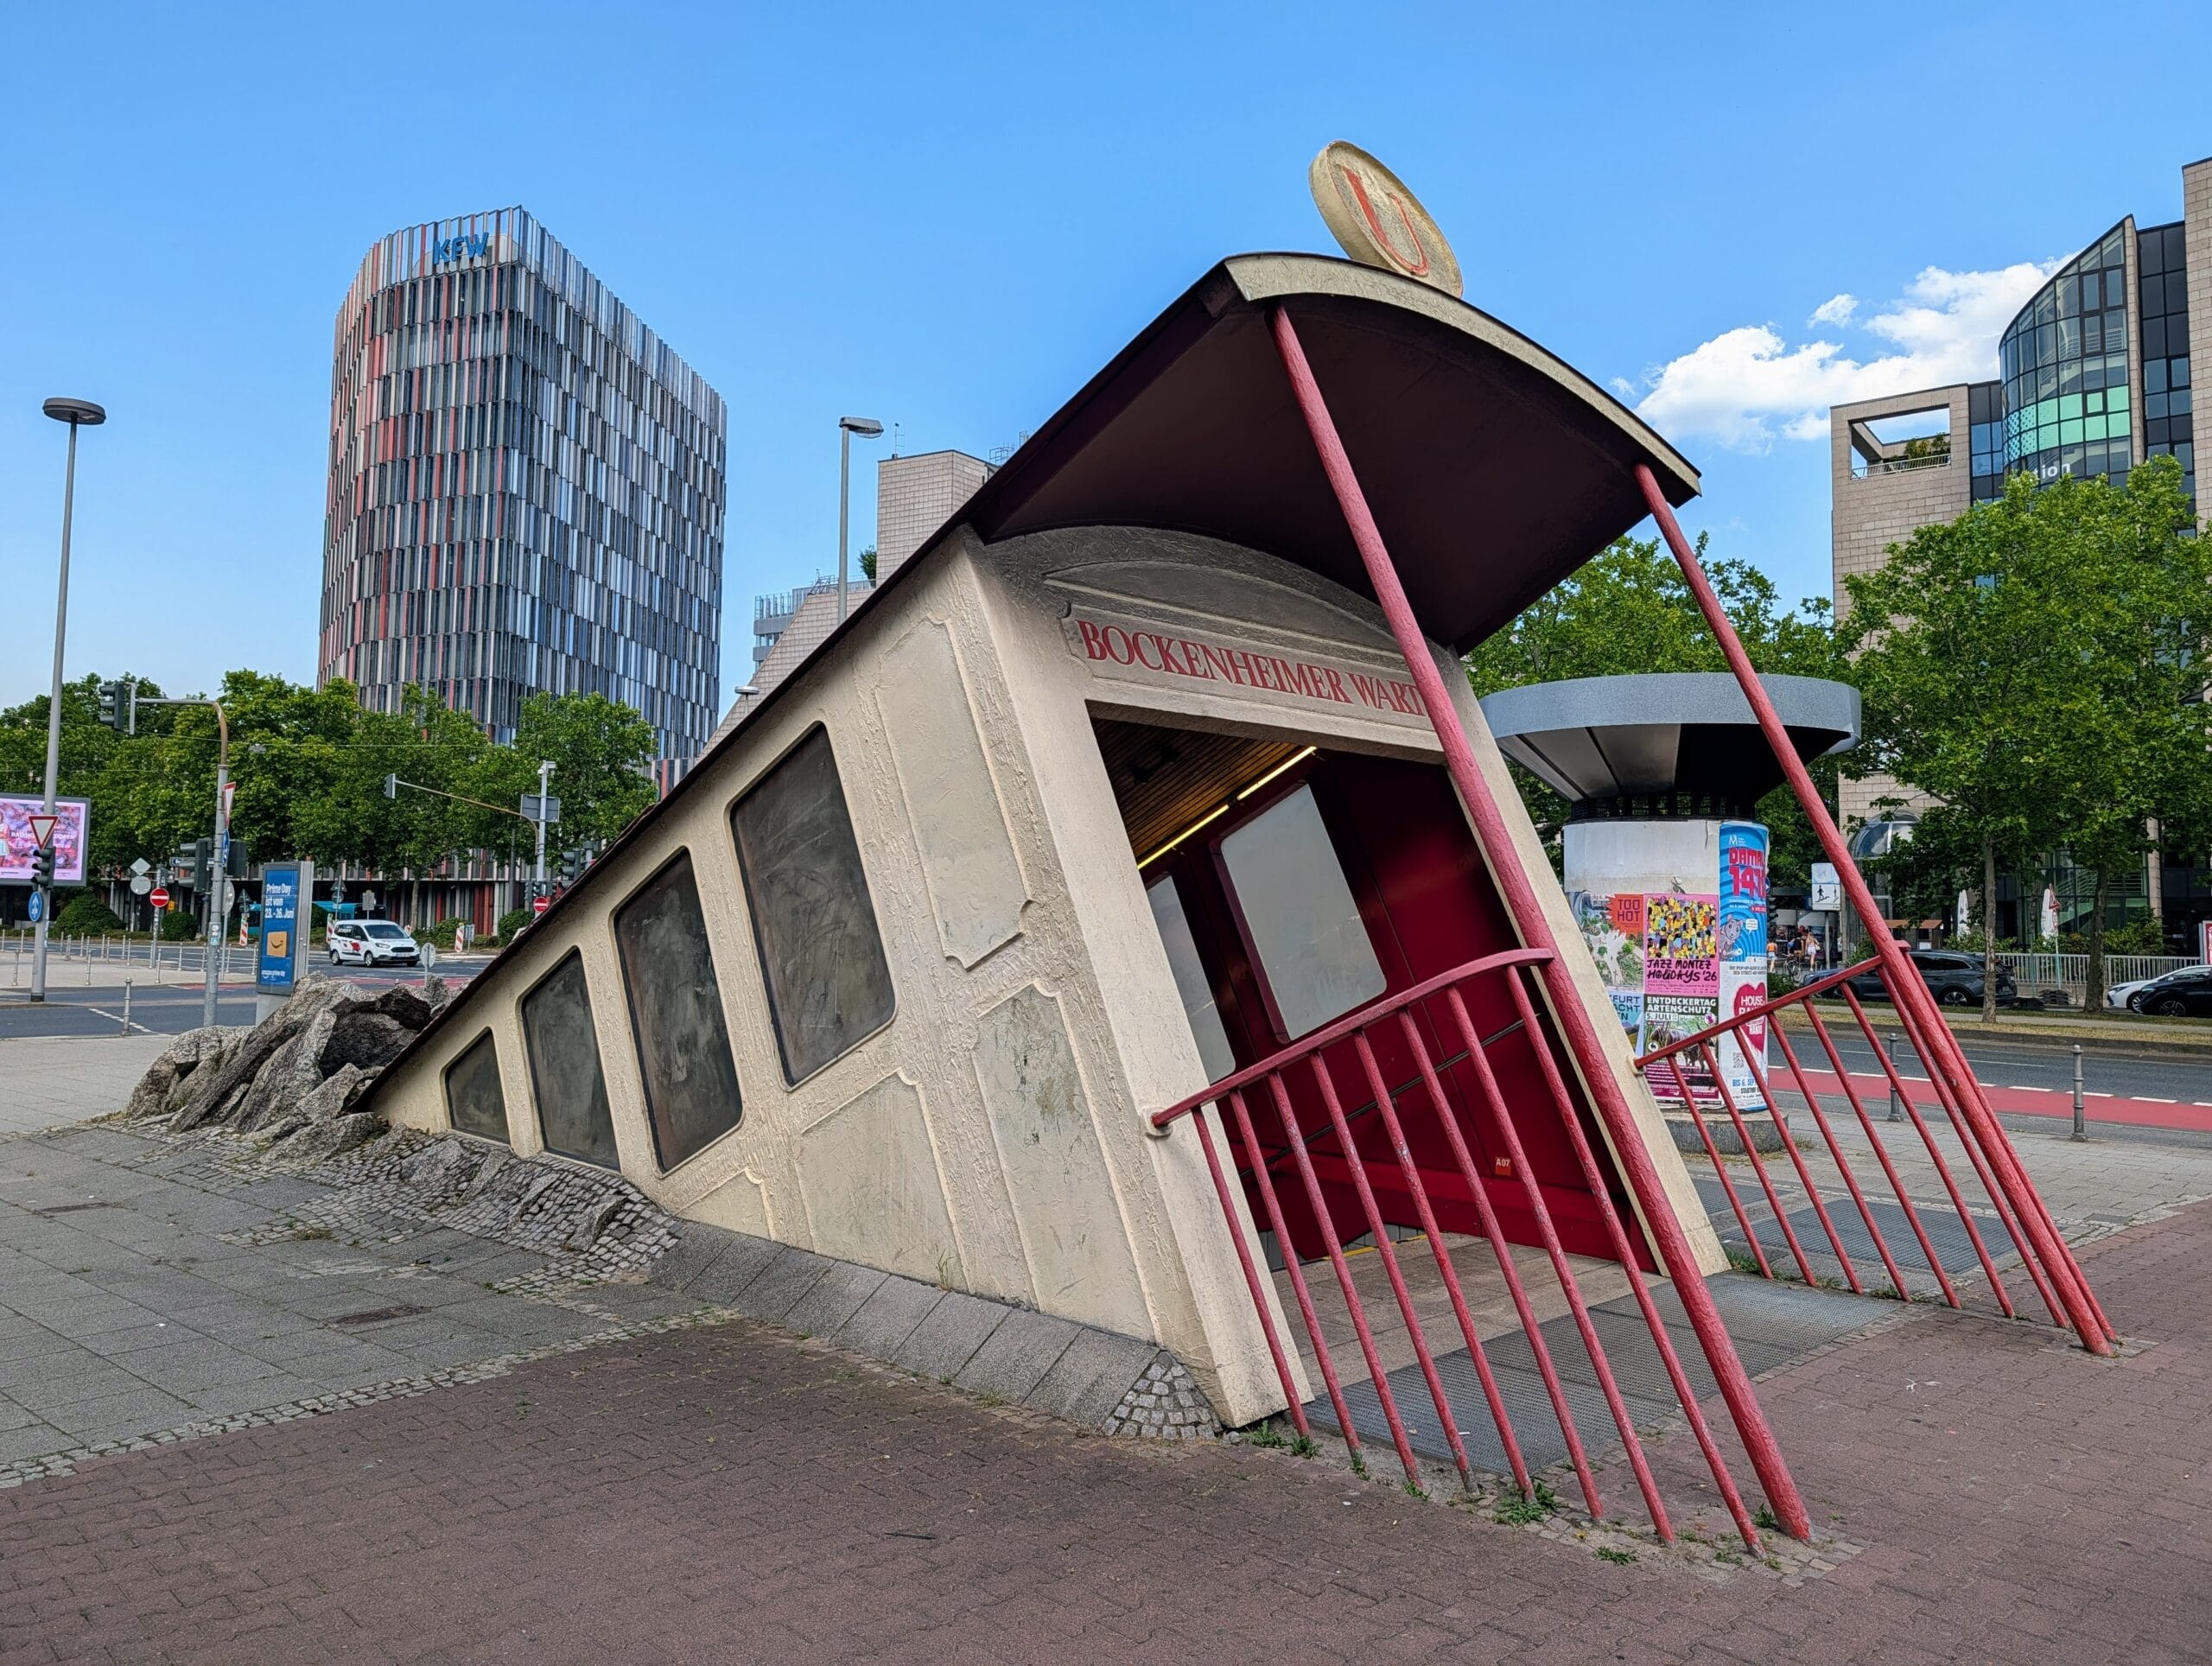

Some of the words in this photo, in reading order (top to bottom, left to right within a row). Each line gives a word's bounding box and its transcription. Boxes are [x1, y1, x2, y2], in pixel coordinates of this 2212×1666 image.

[1338, 164, 1428, 277] U
[1077, 619, 1354, 705] BOCKENHEIMER
[1344, 671, 1427, 718] WART
[266, 883, 281, 894] Prime
[282, 883, 292, 896] Day
[273, 898, 283, 906] vom
[1618, 899, 1640, 910] TOO
[284, 907, 295, 919] Juni
[1617, 911, 1640, 922] HOT
[1647, 959, 1672, 969] JAZZ
[1675, 960, 1712, 970] MONTEZ
[1702, 970, 1717, 982] '26
[1610, 995, 1641, 1004] FURT
[1647, 996, 1717, 1007] ENTDECKERTAG
[1647, 1004, 1712, 1014] ARTENSCHUTZ
